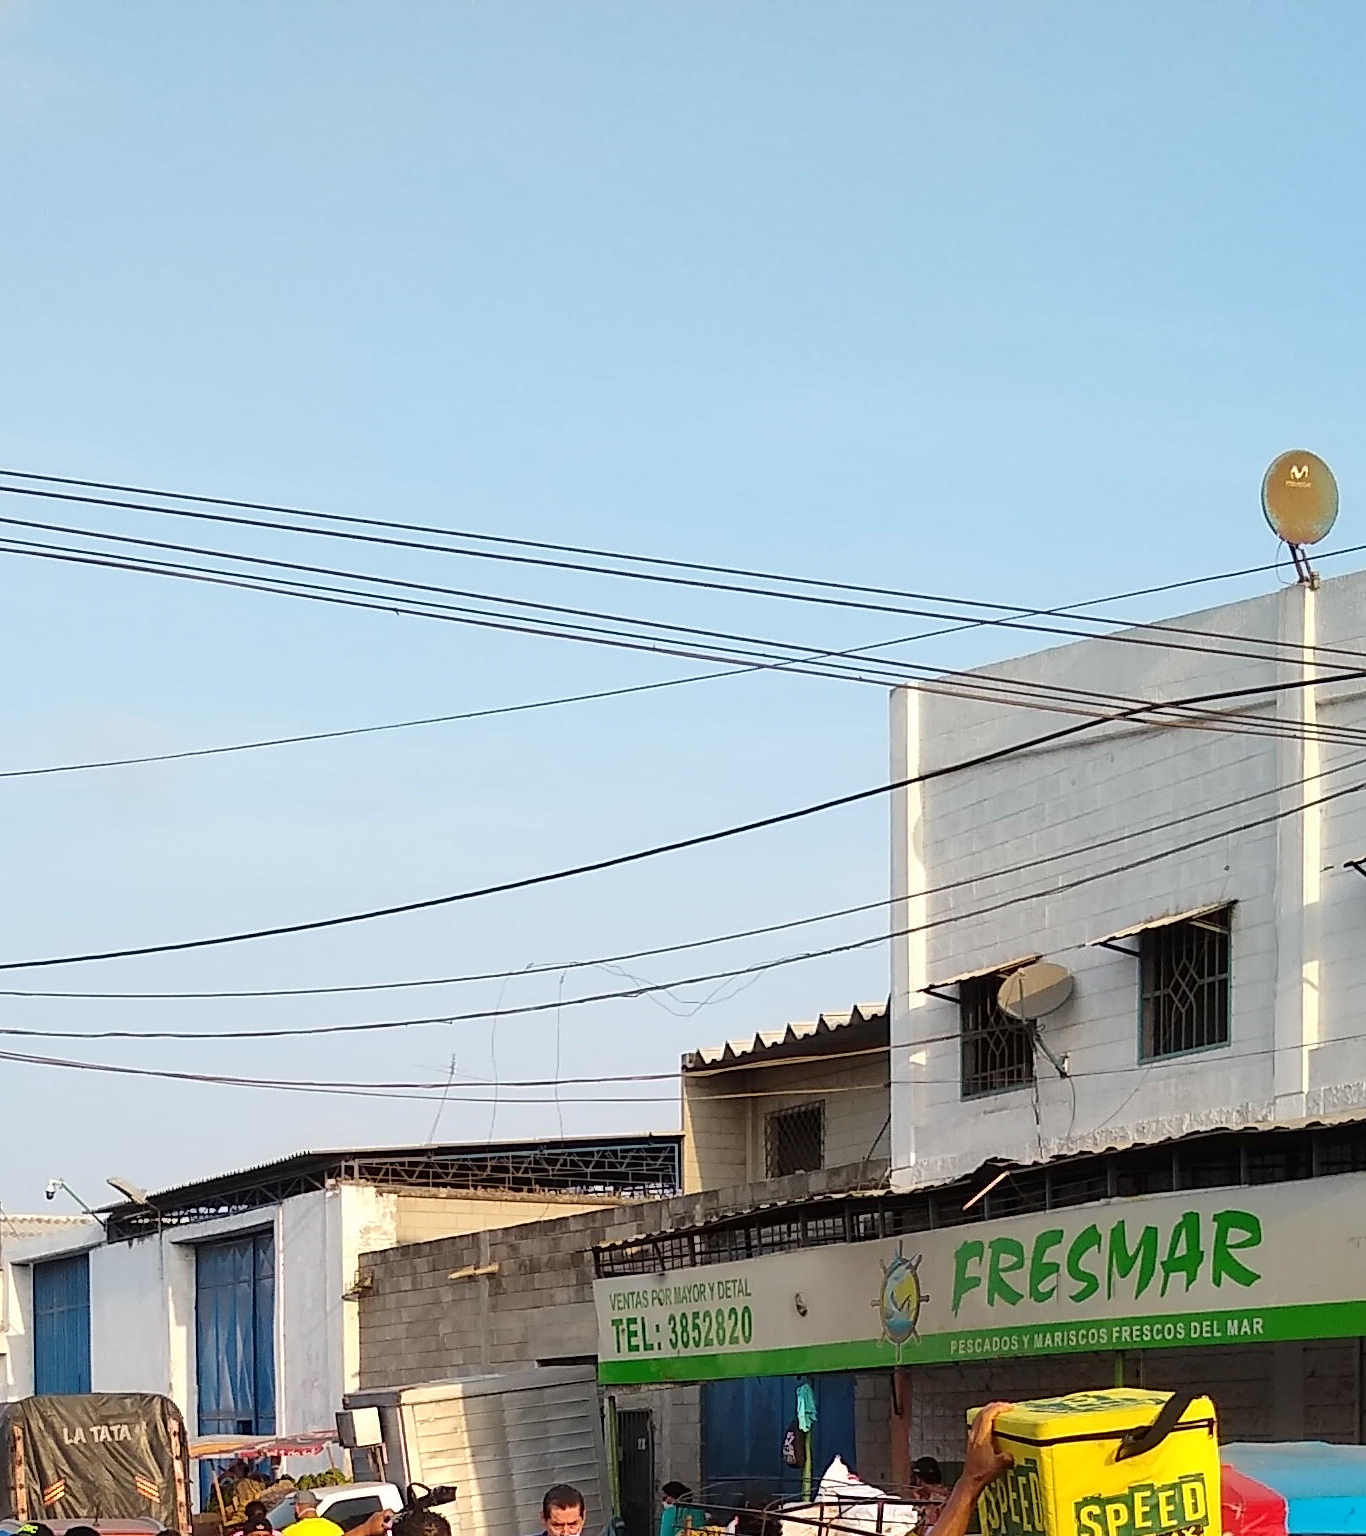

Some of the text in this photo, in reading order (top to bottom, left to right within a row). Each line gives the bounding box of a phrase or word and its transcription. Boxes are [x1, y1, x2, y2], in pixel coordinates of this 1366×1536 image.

[952, 1210, 1262, 1318] FRESMAR
[610, 1278, 751, 1311] VENTAS POR MAYOR Y DETAL
[611, 1305, 753, 1353] TEL: 3852820
[950, 1317, 1264, 1354] PESCADOS Y MARISCOS FRESCOS DEL MAR
[63, 1424, 131, 1445] LA TATA
[985, 1468, 1043, 1535] SPEED
